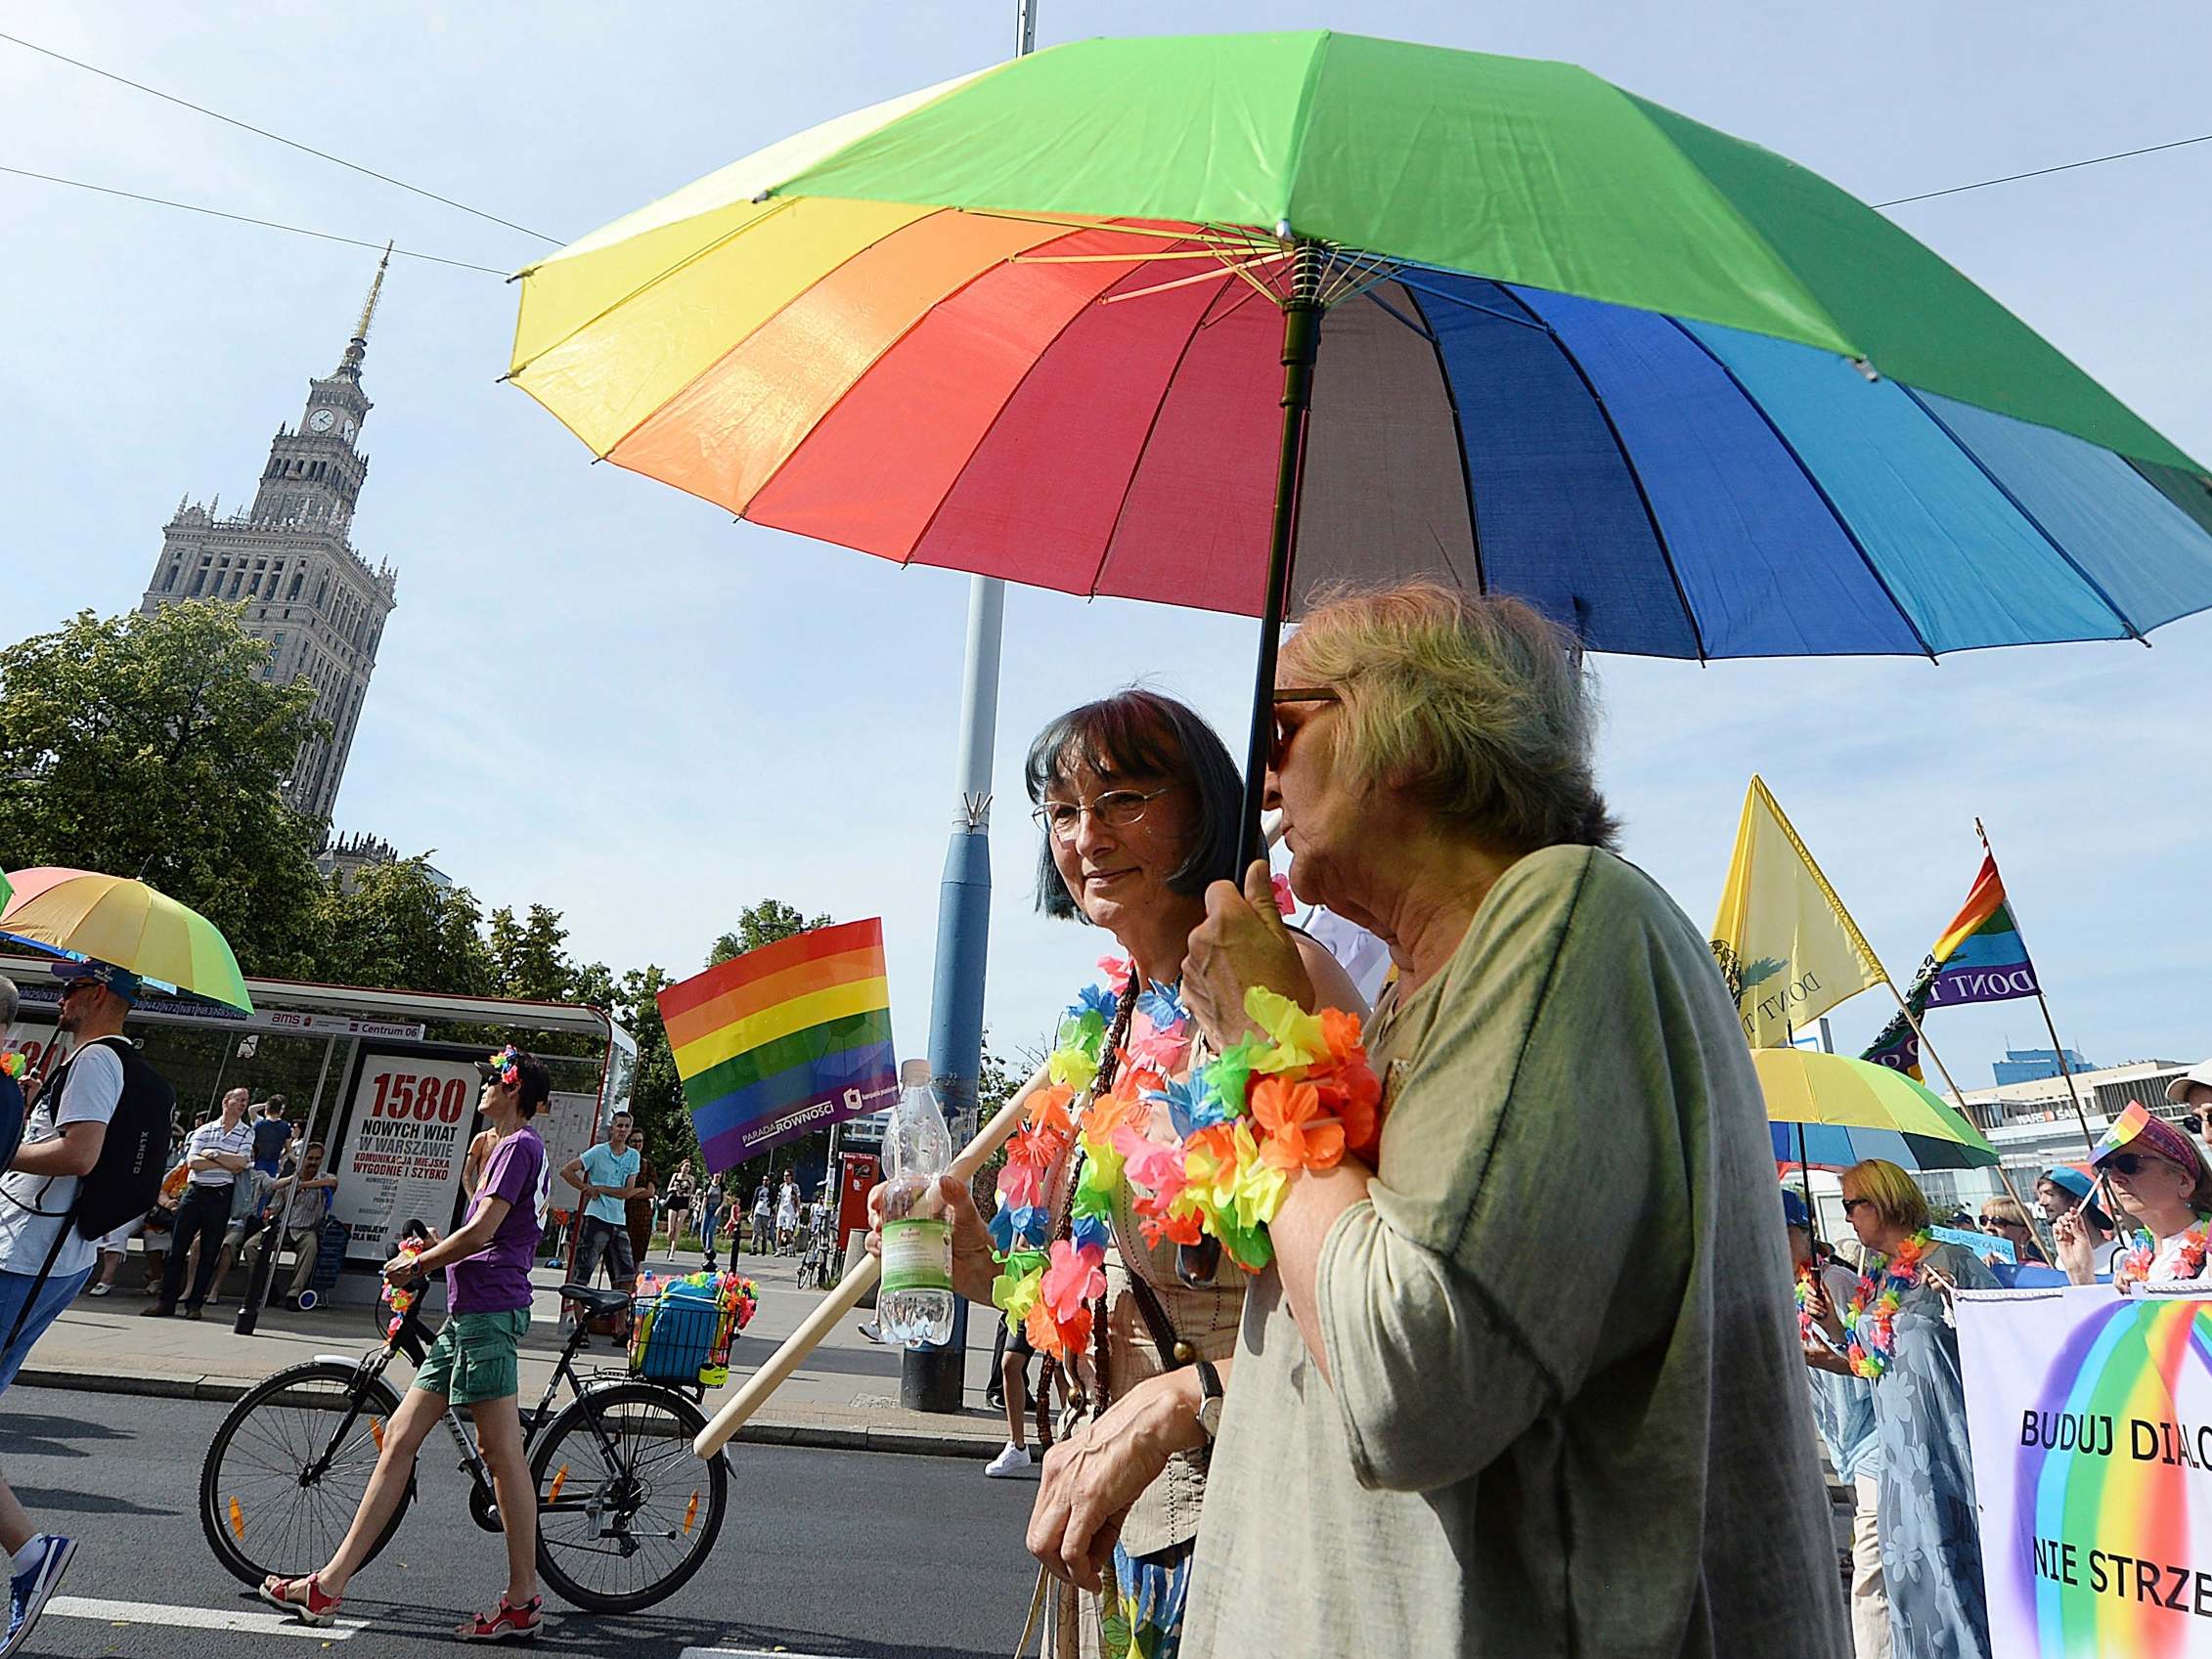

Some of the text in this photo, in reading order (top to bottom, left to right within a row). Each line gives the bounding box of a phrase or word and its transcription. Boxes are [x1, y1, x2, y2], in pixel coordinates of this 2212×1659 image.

[272, 1013, 300, 1025] ams
[362, 1024, 418, 1037] Centrum 06
[372, 1072, 466, 1123] 1580
[361, 1119, 458, 1142] NOWYCH WIAT
[742, 1123, 775, 1144] PARADA
[359, 1137, 454, 1157] W WARSZAWIE
[355, 1153, 450, 1169] KOMUNIKACJA MIEJSKA
[353, 1162, 403, 1177] WYGODNIE
[404, 1167, 409, 1178] I
[412, 1167, 449, 1181] SZYBKO
[2020, 1410, 2114, 1457] BUDUJ
[2032, 1536, 2212, 1619] NIE STRZE
